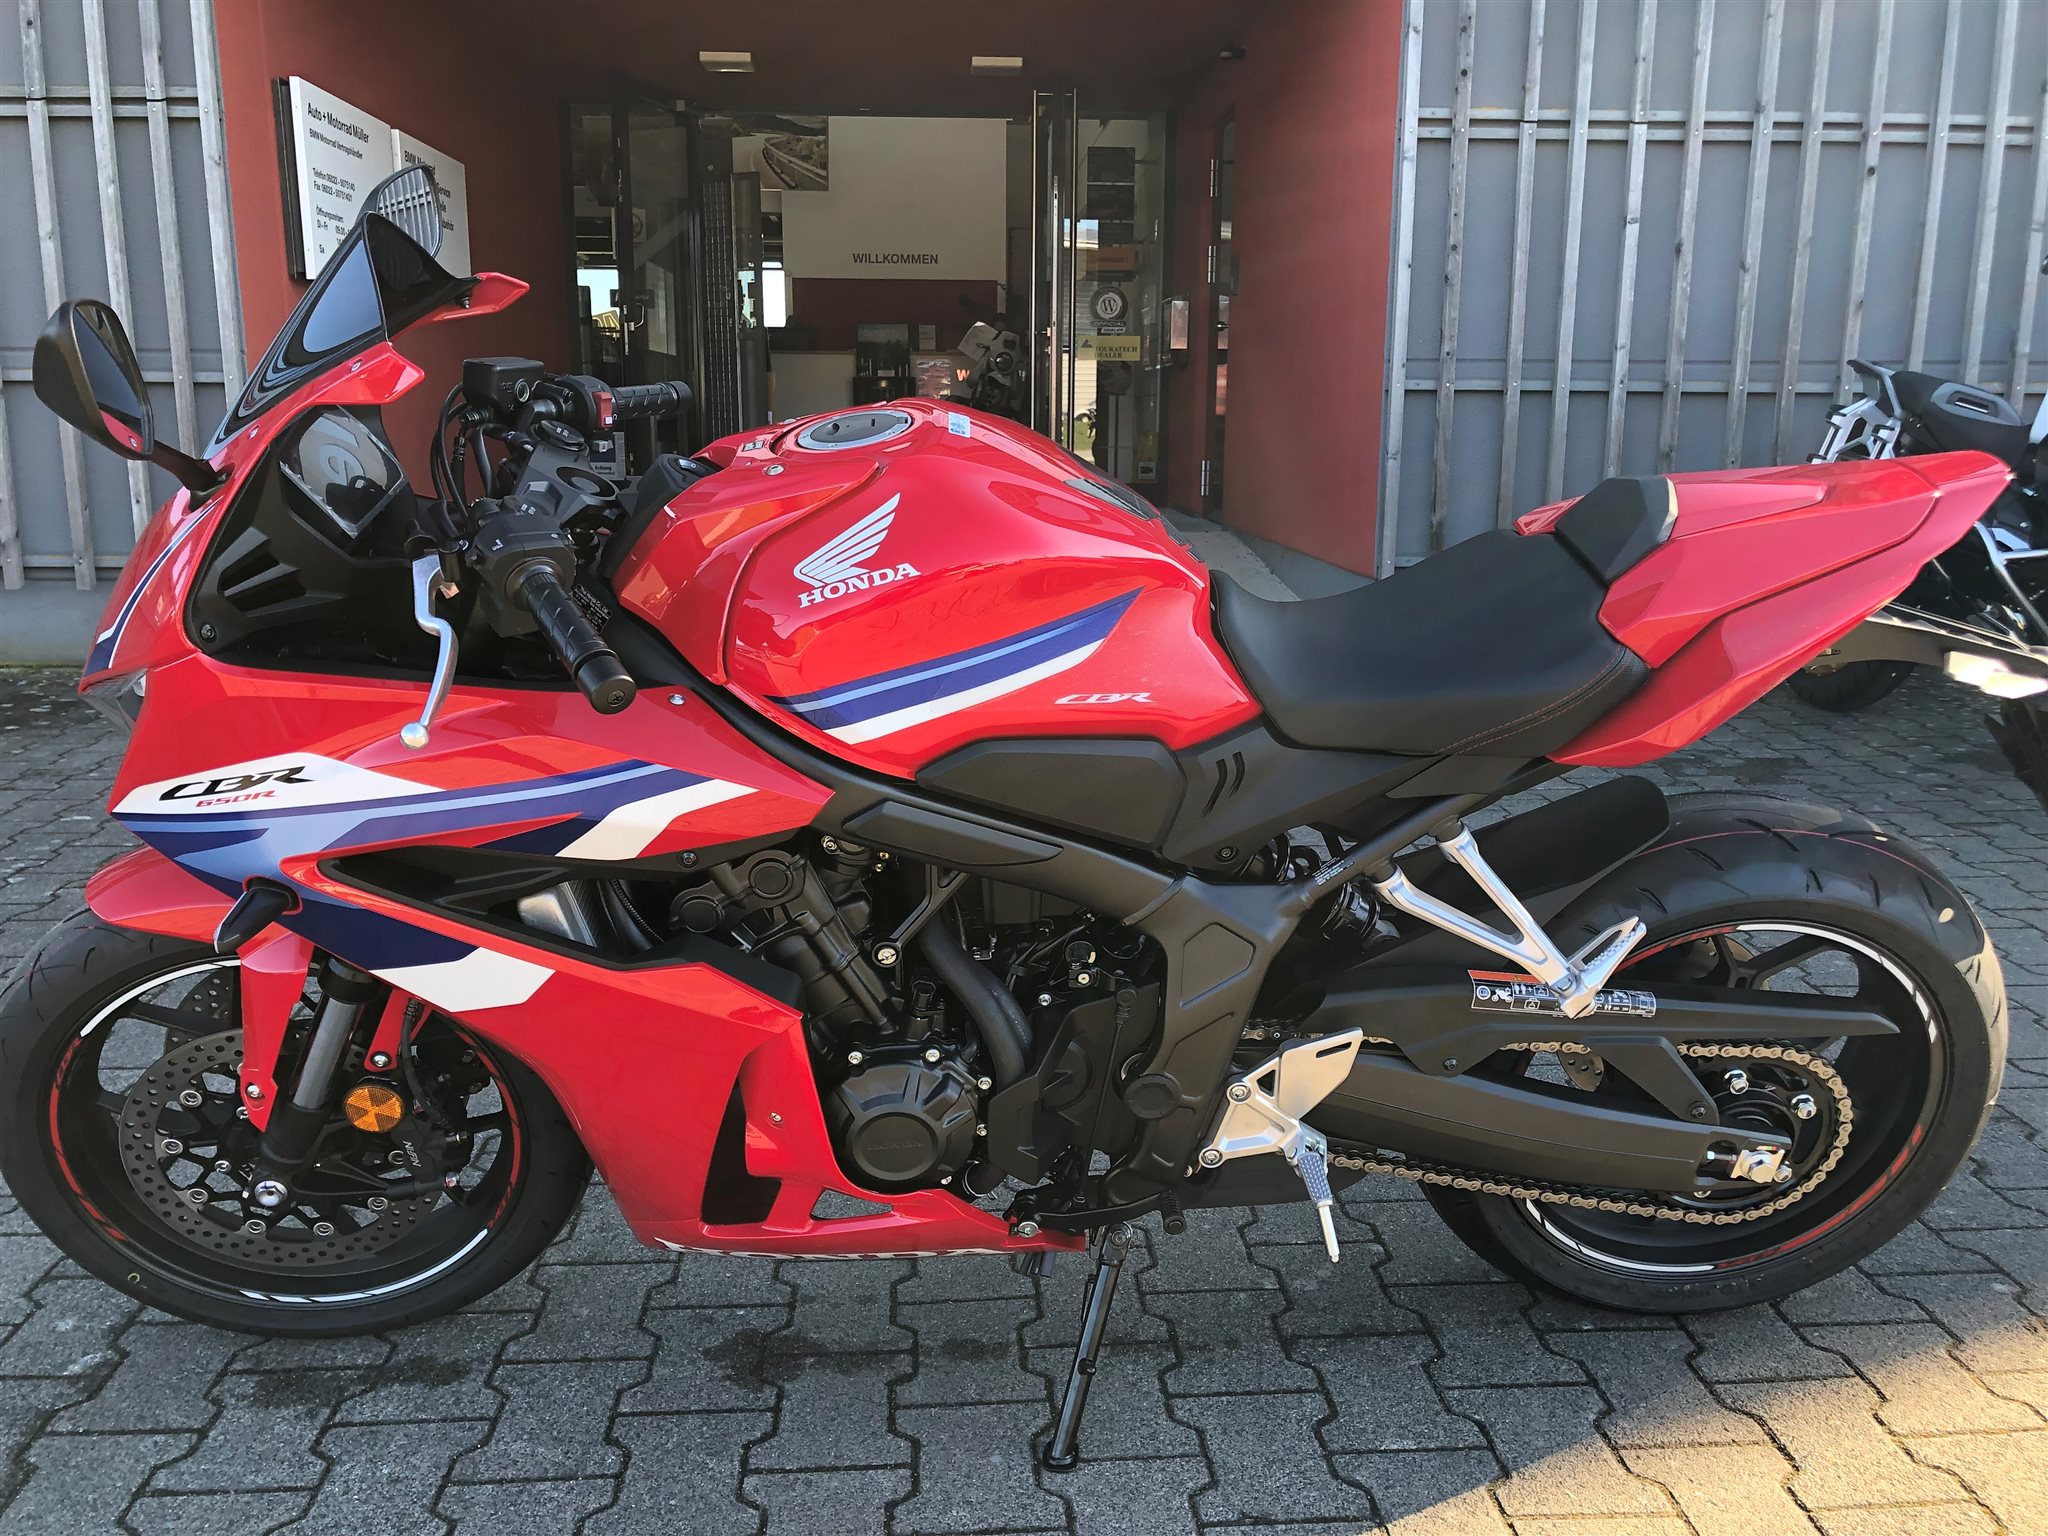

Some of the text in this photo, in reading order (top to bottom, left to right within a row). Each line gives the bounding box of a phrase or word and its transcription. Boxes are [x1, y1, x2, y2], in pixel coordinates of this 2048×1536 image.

[307, 102, 322, 121] Auto
[327, 111, 352, 136] Motorrad
[352, 123, 369, 143] Müller
[852, 253, 939, 265] WILLKOMMEN
[798, 562, 921, 608] HONDA
[1054, 692, 1155, 705] CBR
[159, 765, 316, 801] CBR
[195, 790, 278, 808] 650R
